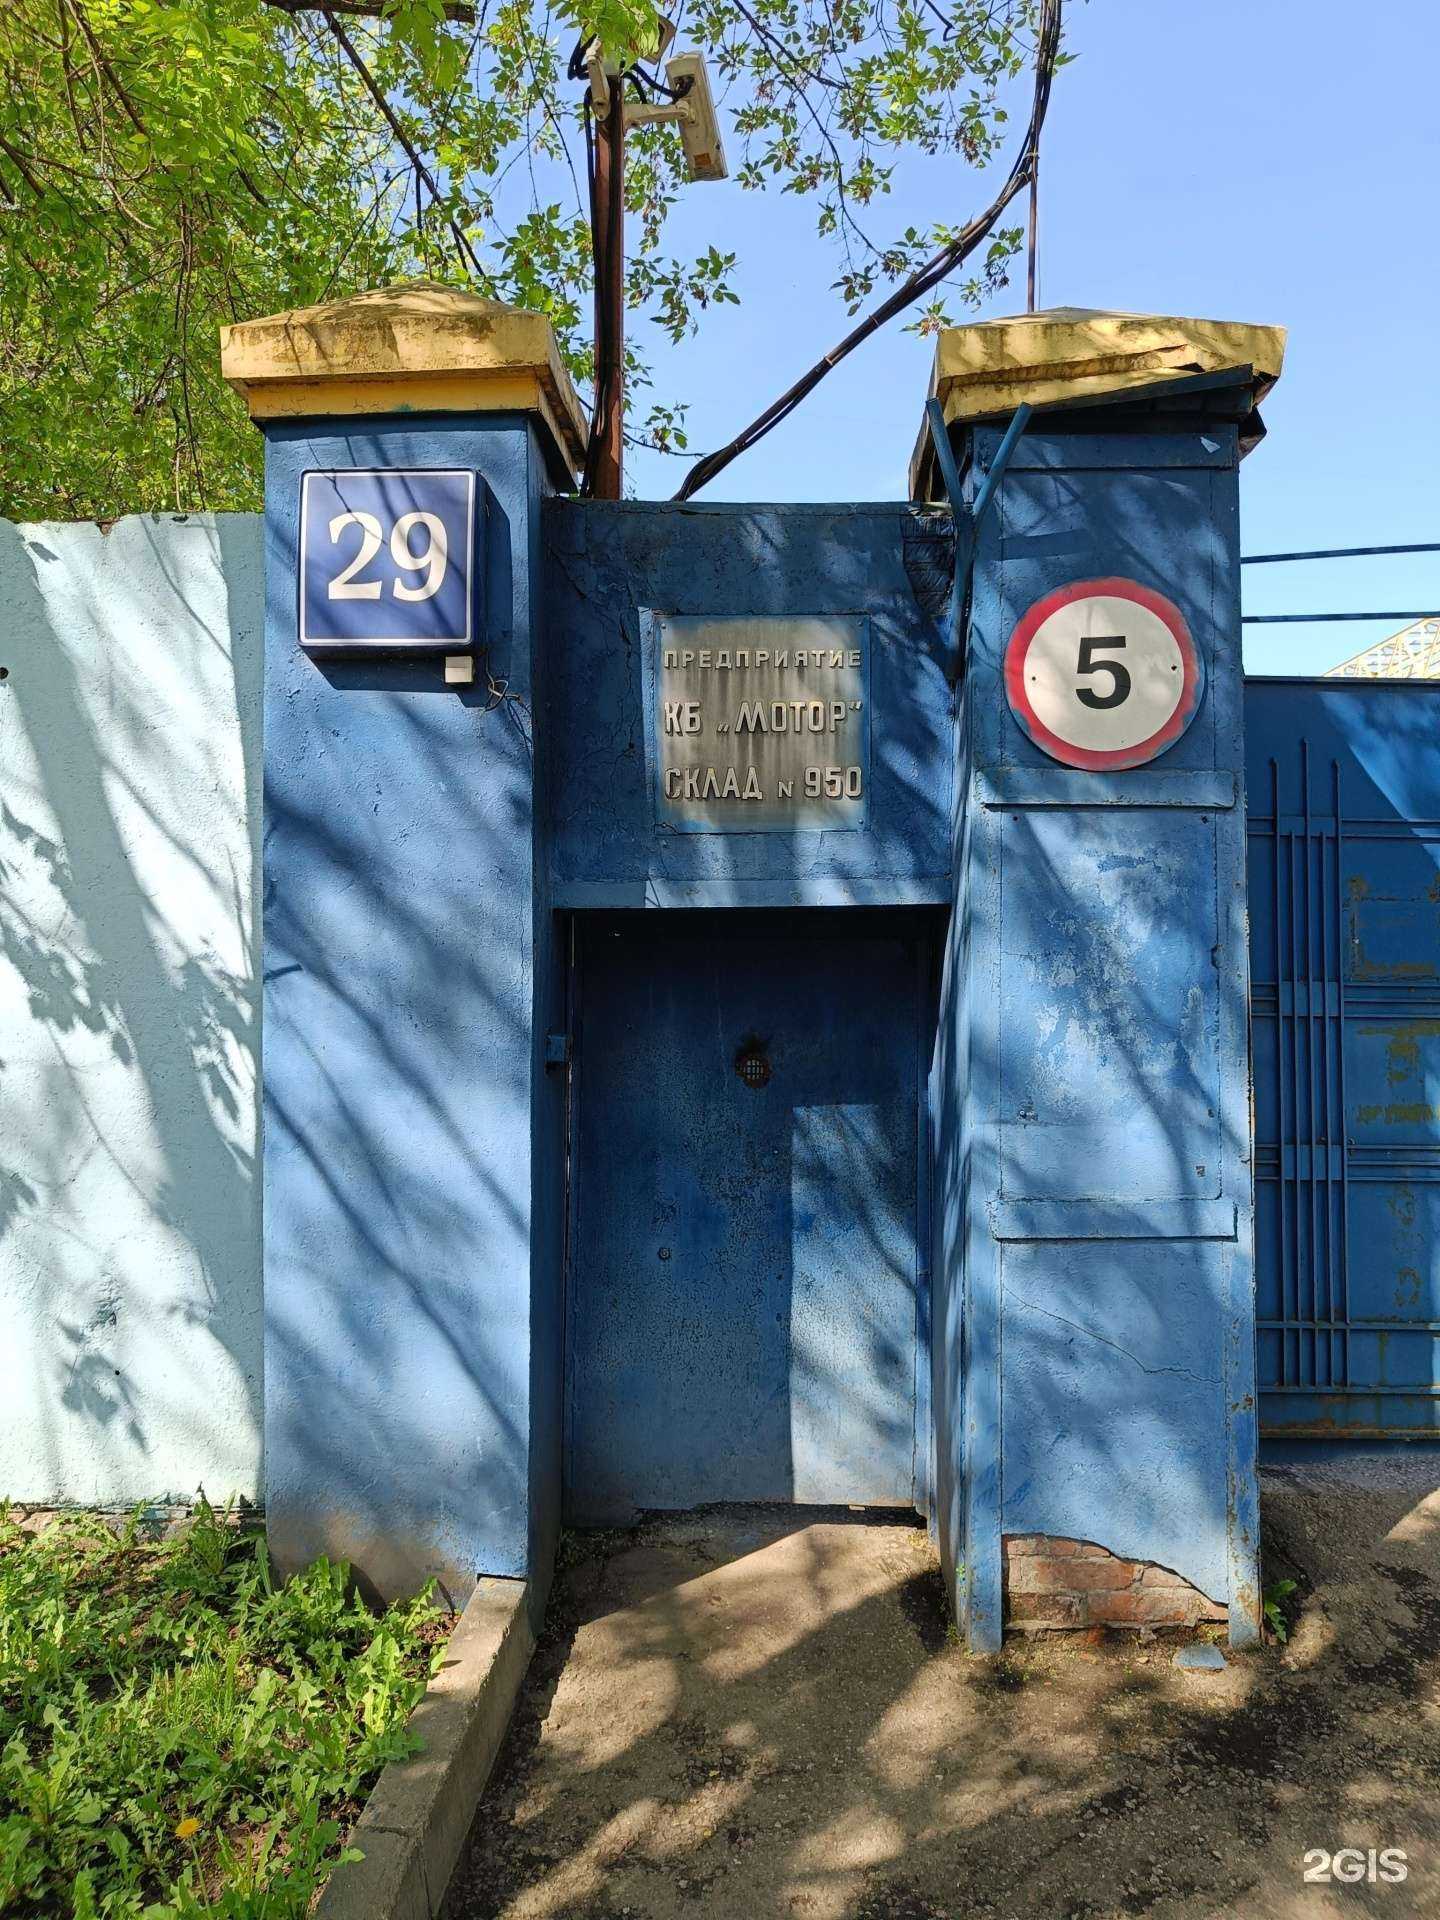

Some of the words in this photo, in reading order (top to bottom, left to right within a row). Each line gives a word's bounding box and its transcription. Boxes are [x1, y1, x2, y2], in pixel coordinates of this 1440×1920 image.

[328, 511, 448, 602] 29
[664, 650, 861, 669] ПРЕДПРИЯТИЕ
[1075, 635, 1132, 710] 5
[664, 702, 700, 734] КБ
[665, 768, 763, 800] СКЛАД
[804, 766, 862, 798] 950
